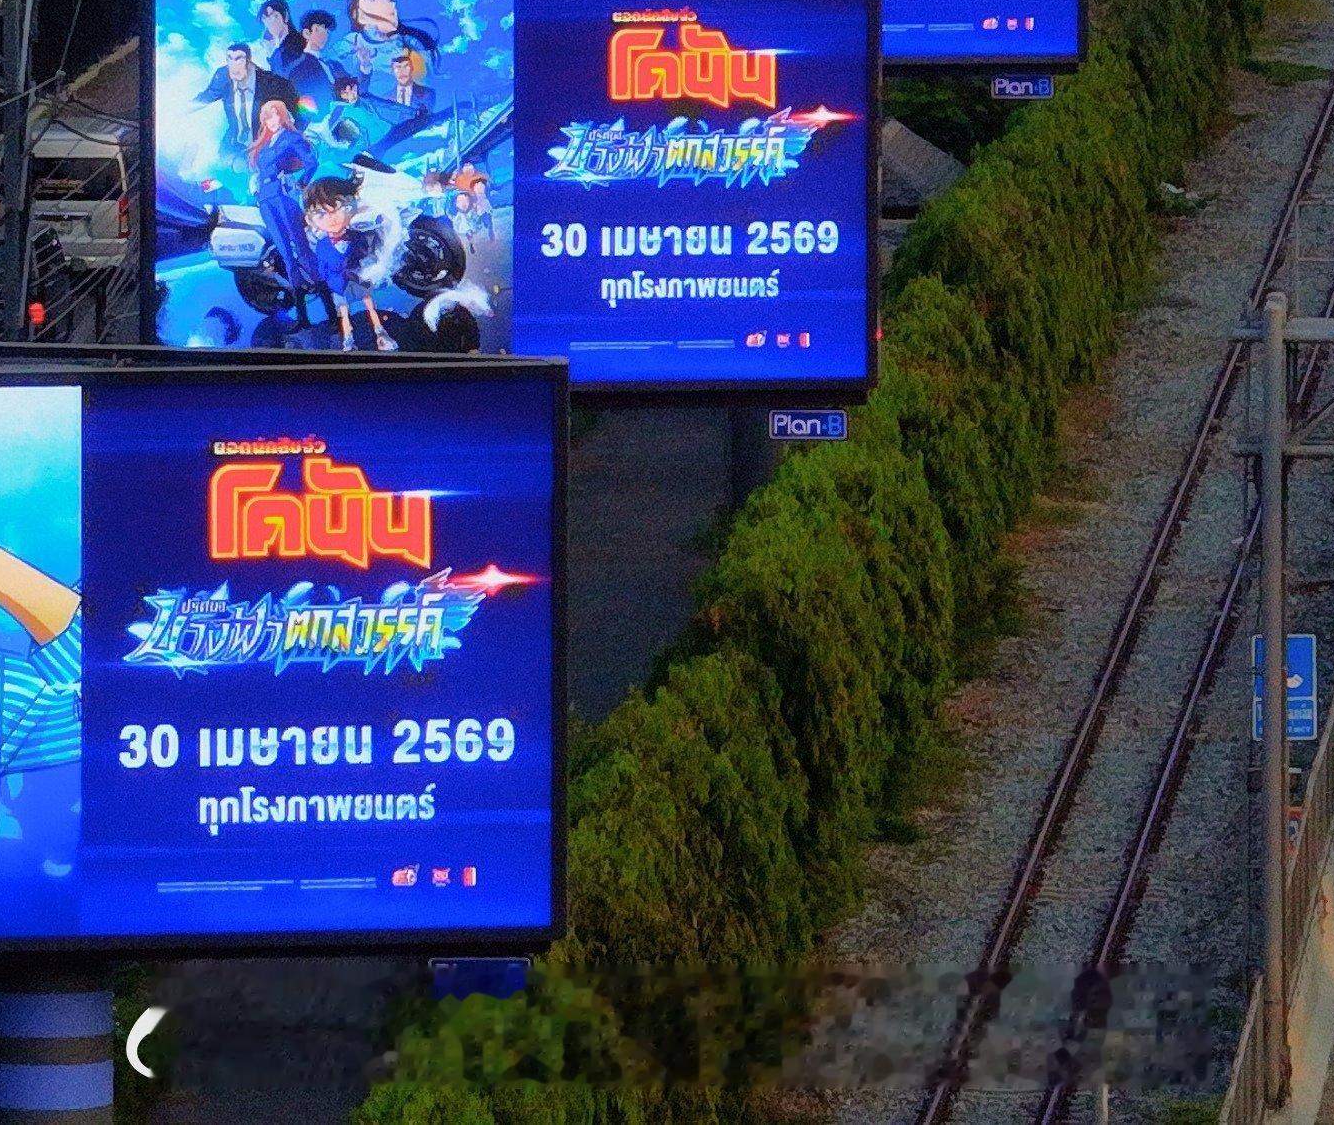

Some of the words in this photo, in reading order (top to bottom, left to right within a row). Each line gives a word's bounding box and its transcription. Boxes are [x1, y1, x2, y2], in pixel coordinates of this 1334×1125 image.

[609, 24, 777, 109] โคนัน
[540, 222, 587, 257] 30
[601, 225, 733, 257] เมษายน
[746, 220, 839, 255] 2569
[601, 269, 780, 309] ทุกโรงภาพยนตร์
[210, 458, 431, 569] โคนัน
[119, 724, 180, 768] 30
[199, 725, 373, 767] เมษายน
[392, 718, 515, 764] 2569
[199, 783, 437, 836] ทุกโรงภาพยนตร์
